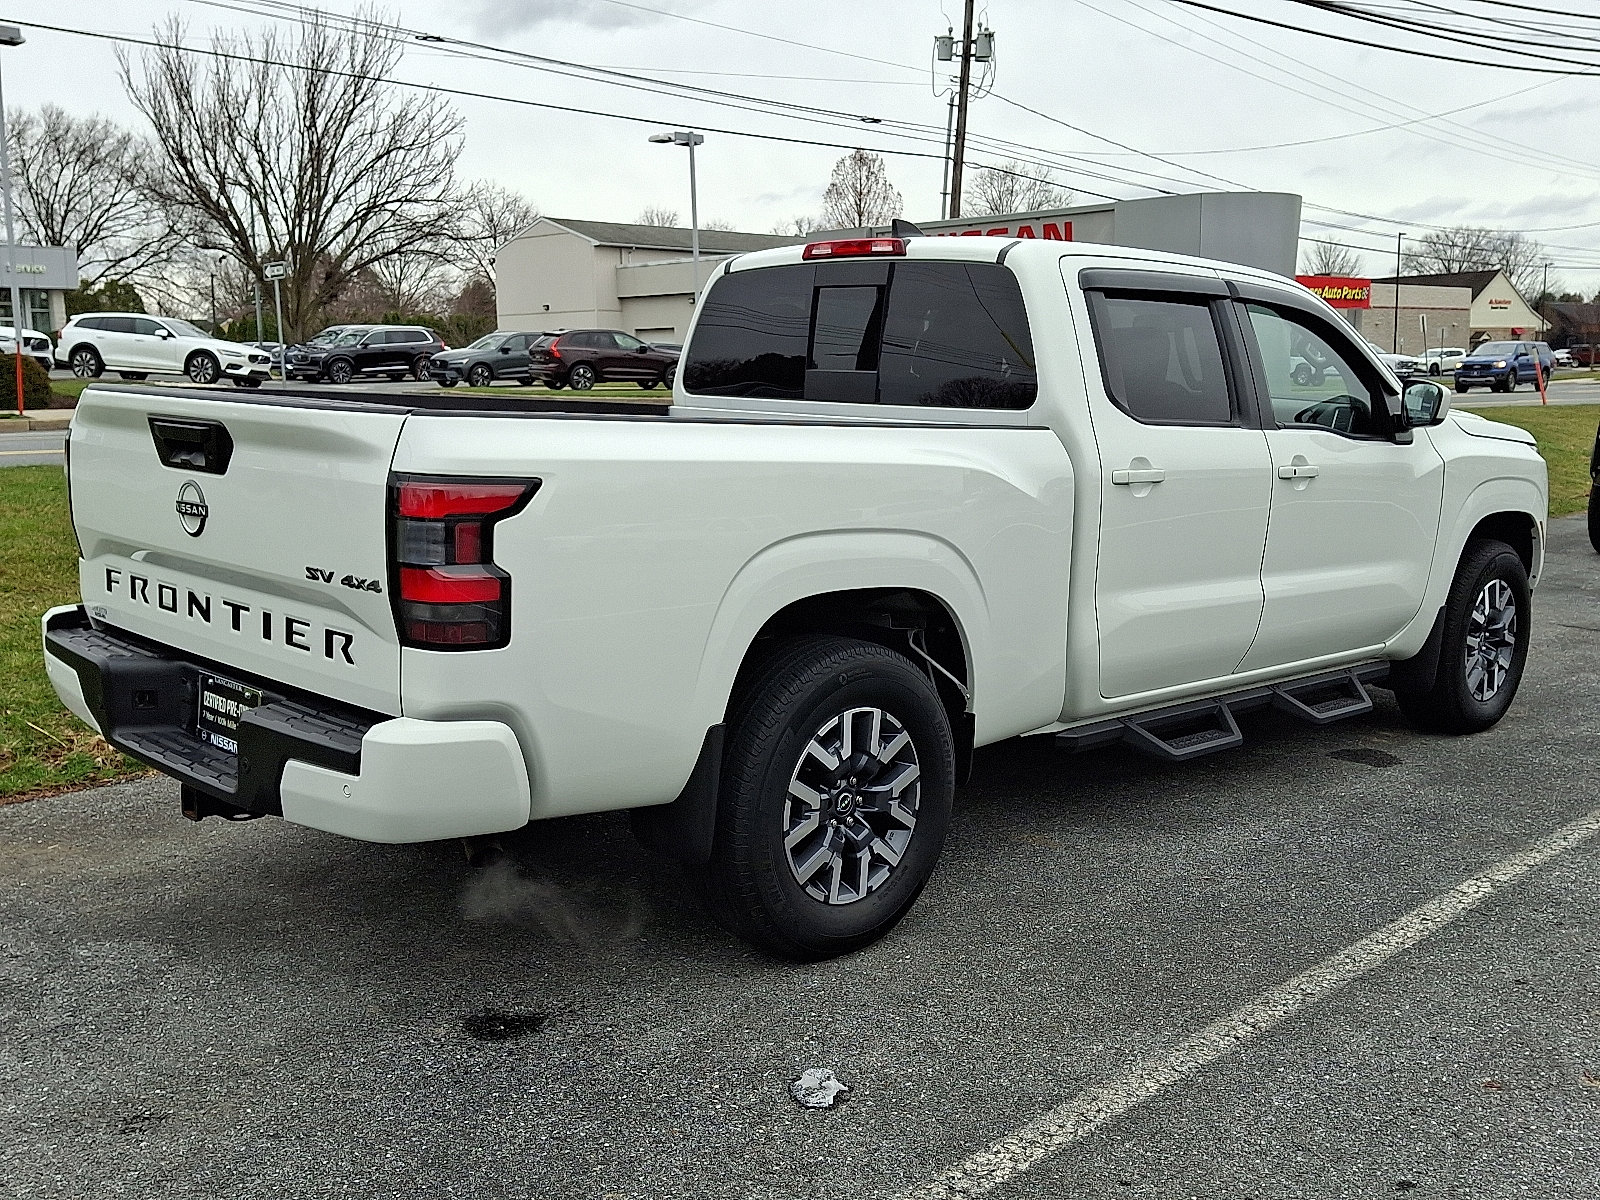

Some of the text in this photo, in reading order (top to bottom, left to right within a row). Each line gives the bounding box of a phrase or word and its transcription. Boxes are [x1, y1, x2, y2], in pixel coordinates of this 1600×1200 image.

[1322, 285, 1341, 300] Auto
[1342, 286, 1362, 300] Parts
[305, 566, 334, 584] SV
[105, 567, 355, 665] FRONTIER
[204, 691, 226, 713] CERTIFIED
[206, 711, 214, 722] Year
[211, 734, 238, 754] NISSAN
